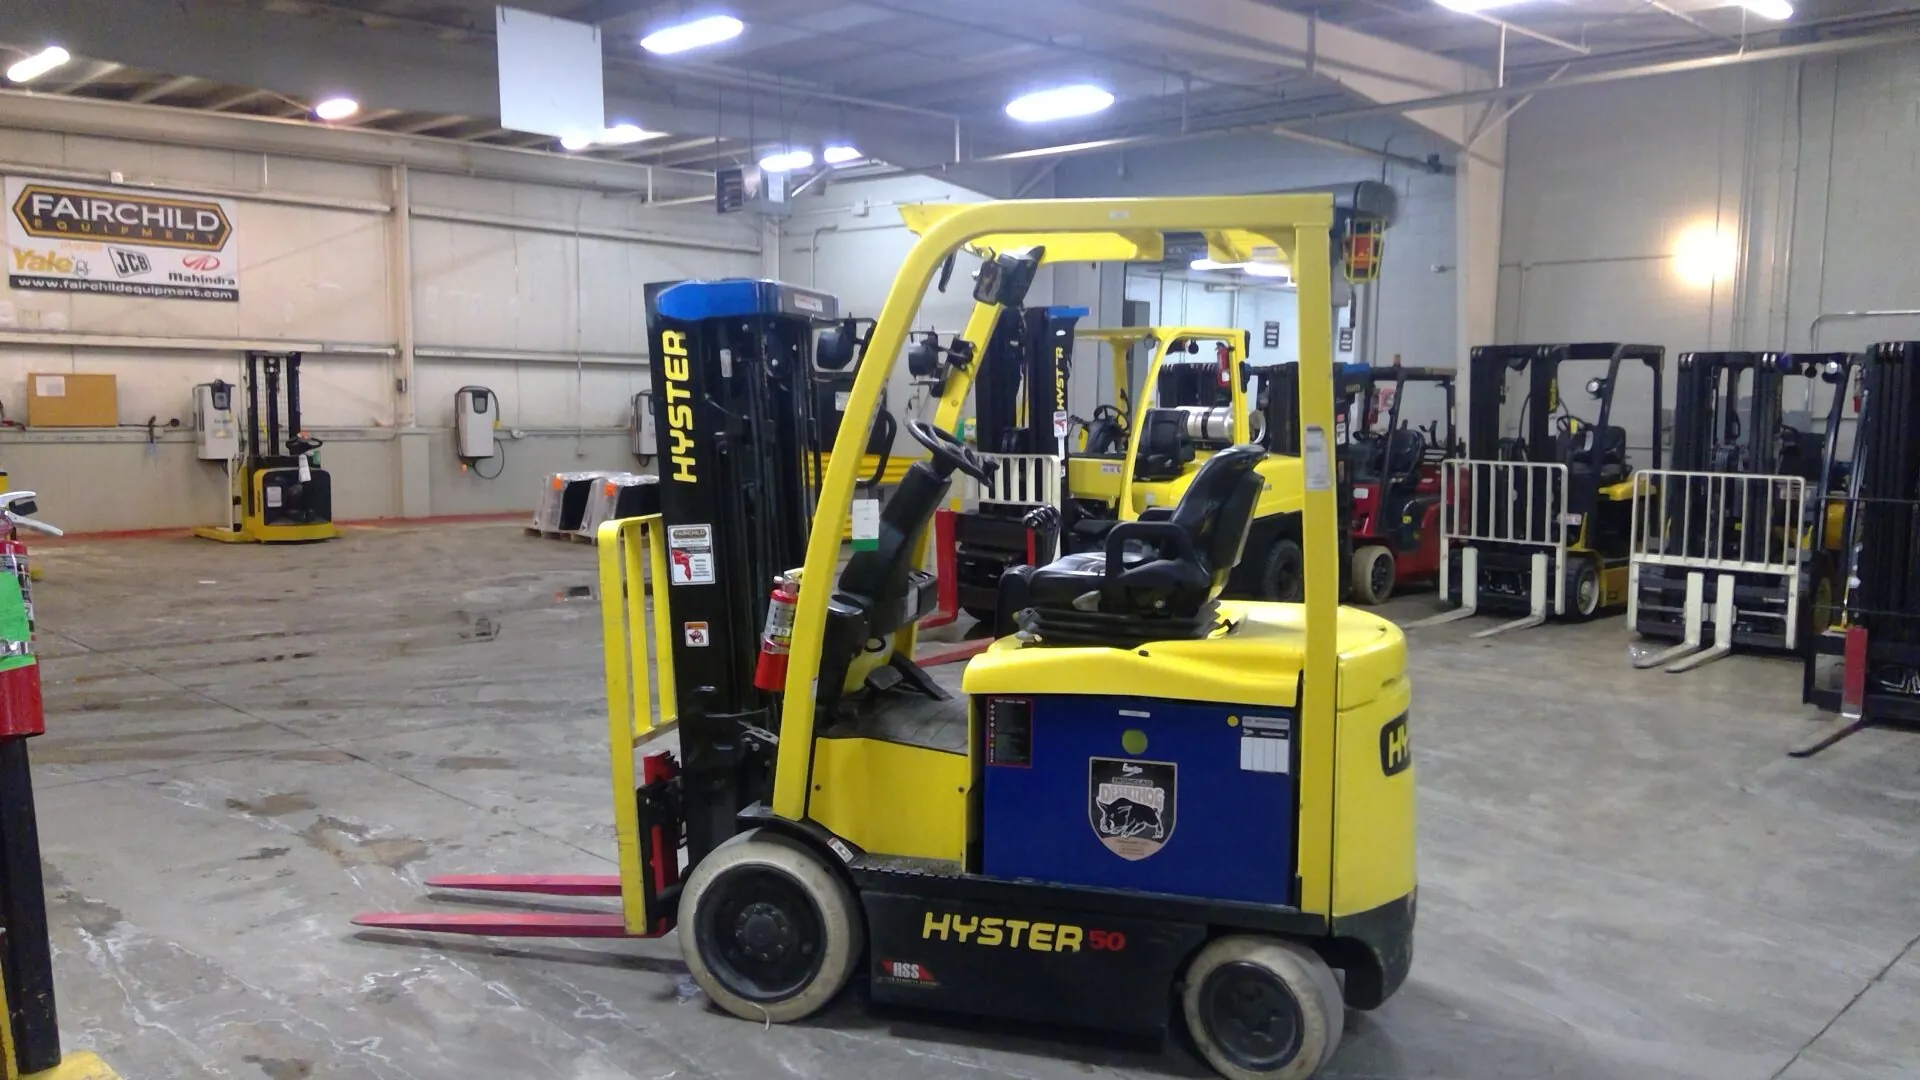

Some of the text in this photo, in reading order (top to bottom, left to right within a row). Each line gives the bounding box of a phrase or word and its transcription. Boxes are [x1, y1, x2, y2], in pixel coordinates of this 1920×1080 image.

[32, 194, 220, 232] FAIRCHILD
[34, 217, 214, 242] EQUIPMENT
[13, 247, 73, 273] Yale
[116, 251, 149, 274] JCB
[18, 279, 232, 299] www.fairchildequipment.com
[169, 272, 235, 286] Mahindra
[662, 329, 697, 483] HYSTER
[922, 911, 1126, 952] HYSTER 50
[893, 962, 920, 979] HSS
